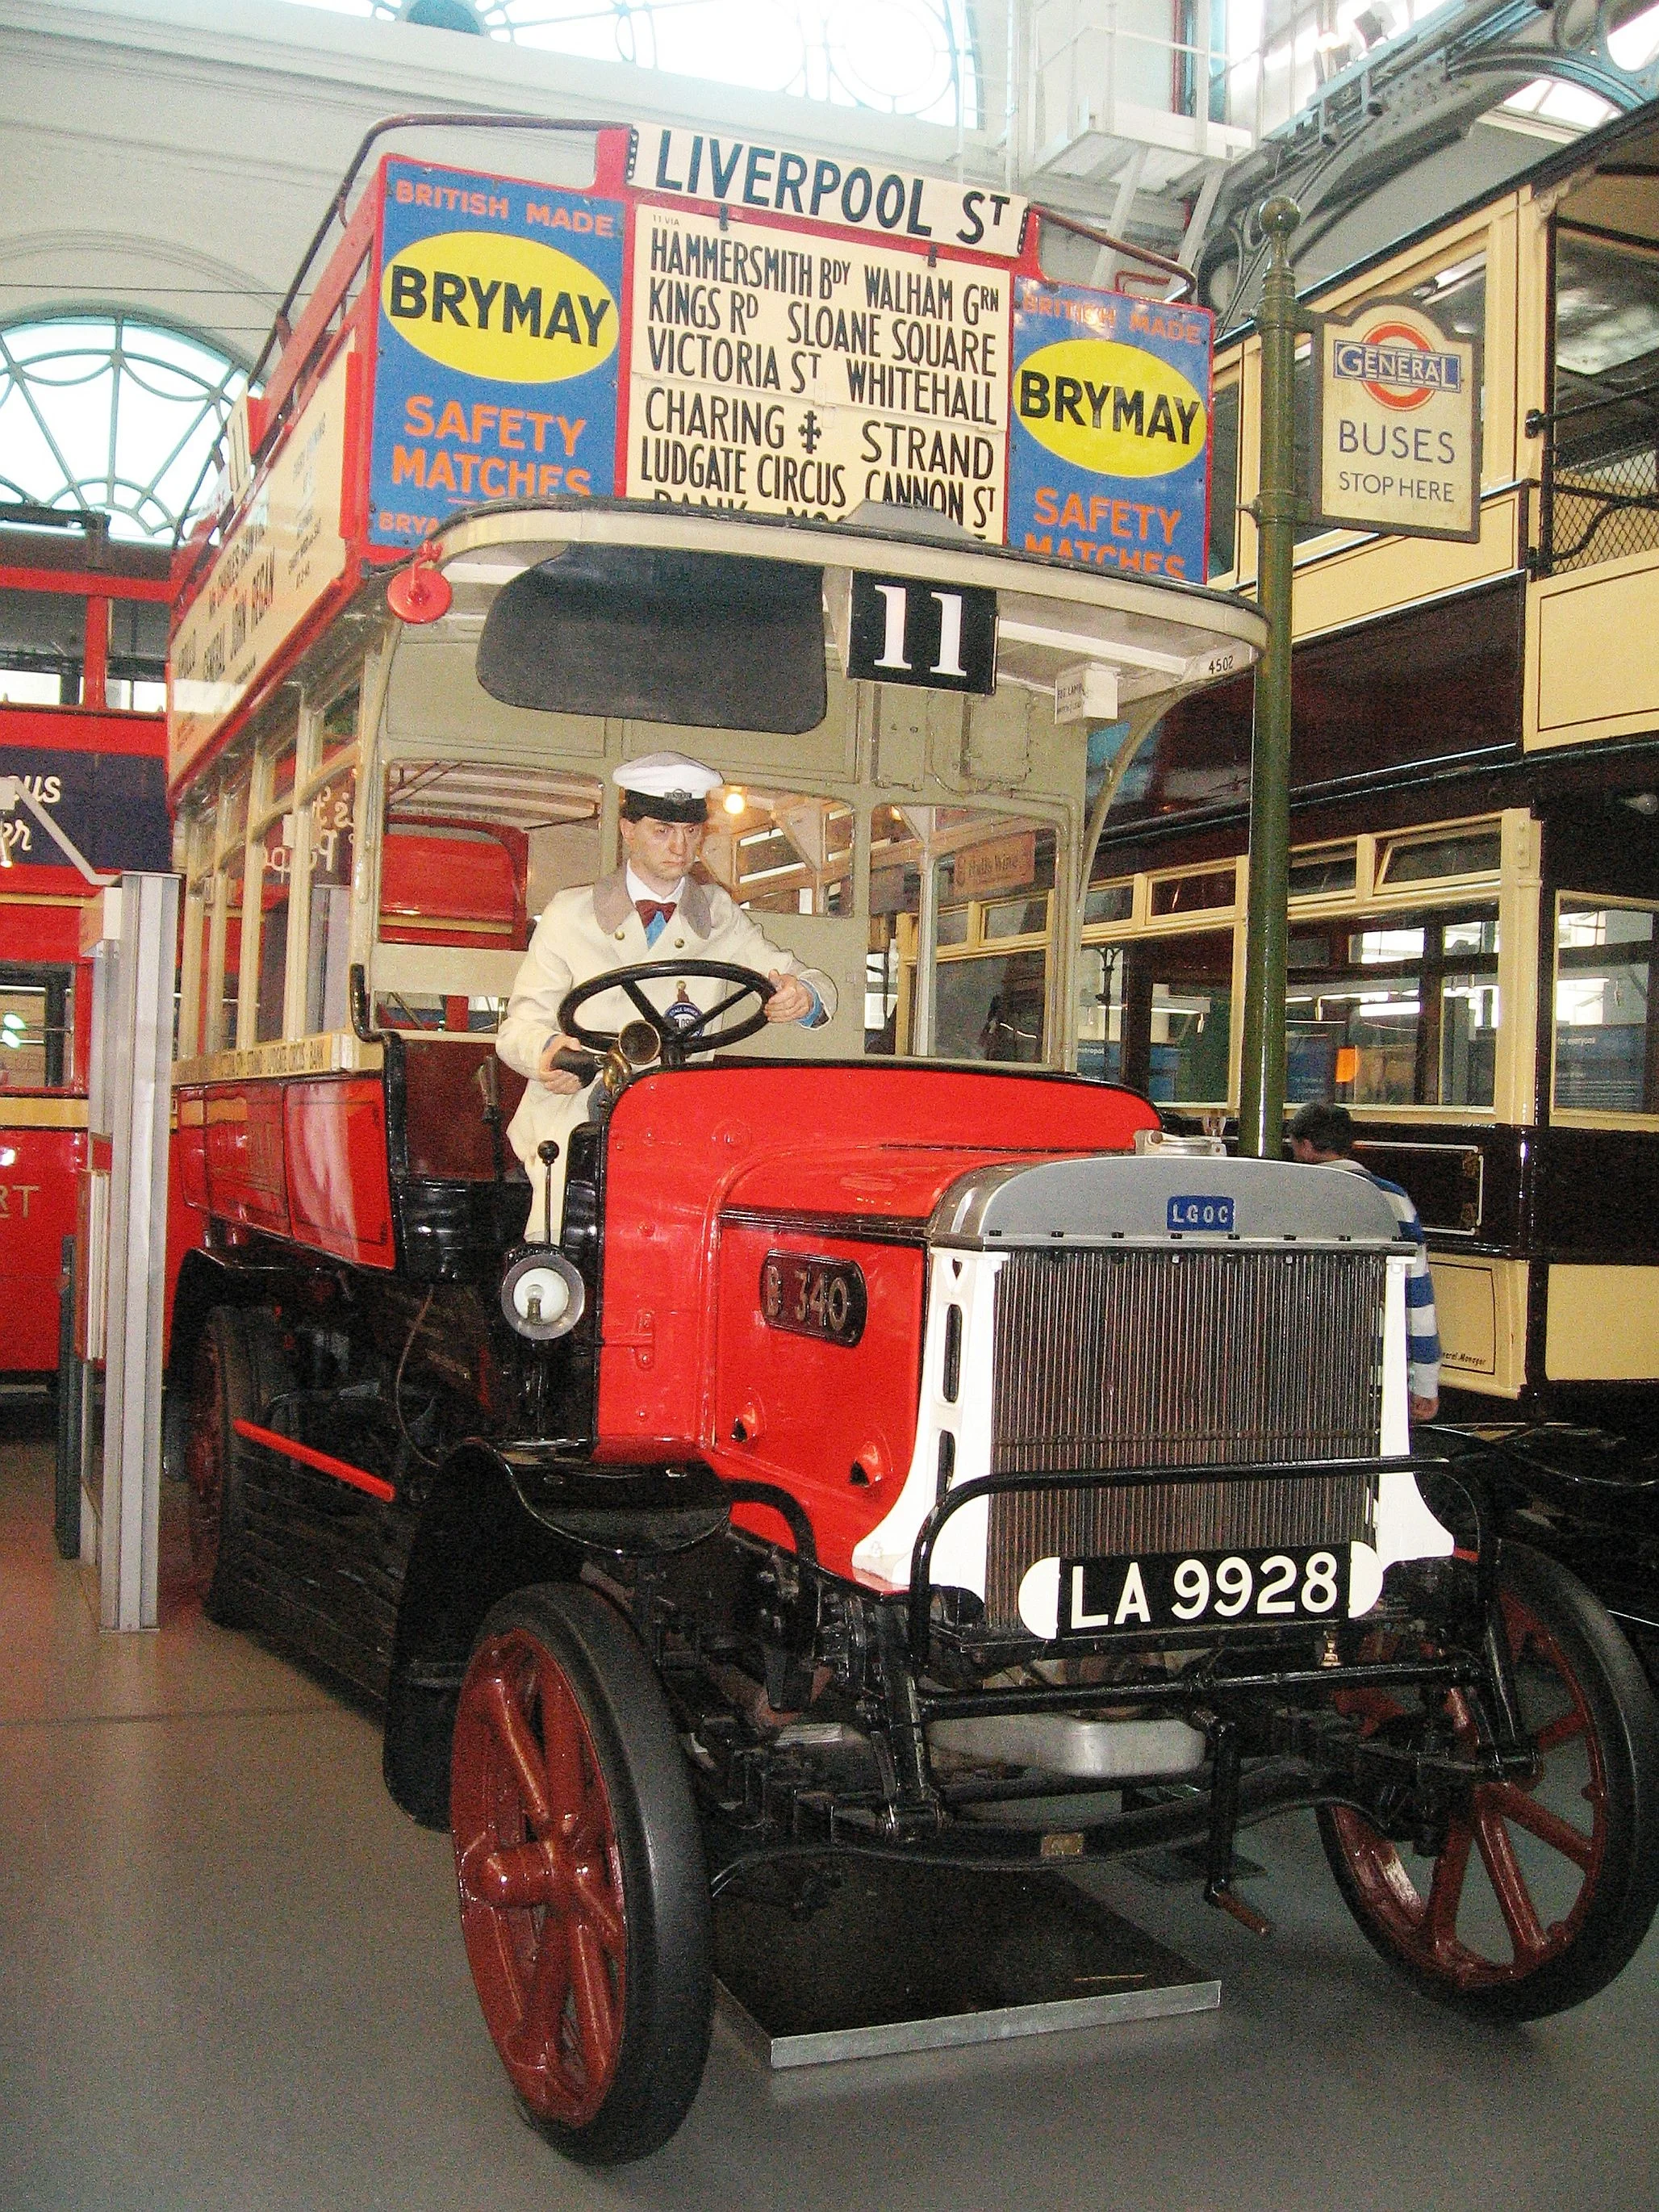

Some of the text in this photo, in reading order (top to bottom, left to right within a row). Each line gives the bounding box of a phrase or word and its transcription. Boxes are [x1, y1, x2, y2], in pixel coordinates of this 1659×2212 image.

[395, 179, 615, 238] BRITISH MADE
[656, 129, 1010, 245] LIVERPOOL ST
[664, 216, 680, 226] VIA
[390, 265, 611, 347] BRYMAY
[650, 228, 999, 326] HAMMERSMITH BDY WALHAM GRN
[649, 276, 997, 378] KINGS RD SLOANE SQUARE
[1022, 292, 1202, 346] BRITISH MADE
[647, 326, 997, 426] VICTORIA ST WHITEHALL
[1337, 344, 1460, 388] GENERAL
[403, 394, 588, 457] SAFETY
[645, 387, 994, 480] CHARING STRAND
[1020, 369, 1201, 445] BRYMAY
[391, 445, 592, 499] MATCHES
[1339, 420, 1456, 464] BUSES
[641, 435, 747, 495] LUDGATE
[757, 454, 846, 508] CIRCUS
[864, 469, 964, 527] CANNON
[972, 485, 997, 529] ST
[1339, 471, 1456, 503] STOP HERE
[1033, 486, 1183, 546] SAFETY
[873, 583, 967, 677] 11
[1208, 654, 1234, 675] 4502
[1172, 1202, 1228, 1223] LGOC
[794, 1268, 849, 1332] 340
[1070, 1551, 1339, 1629] LA 9928
